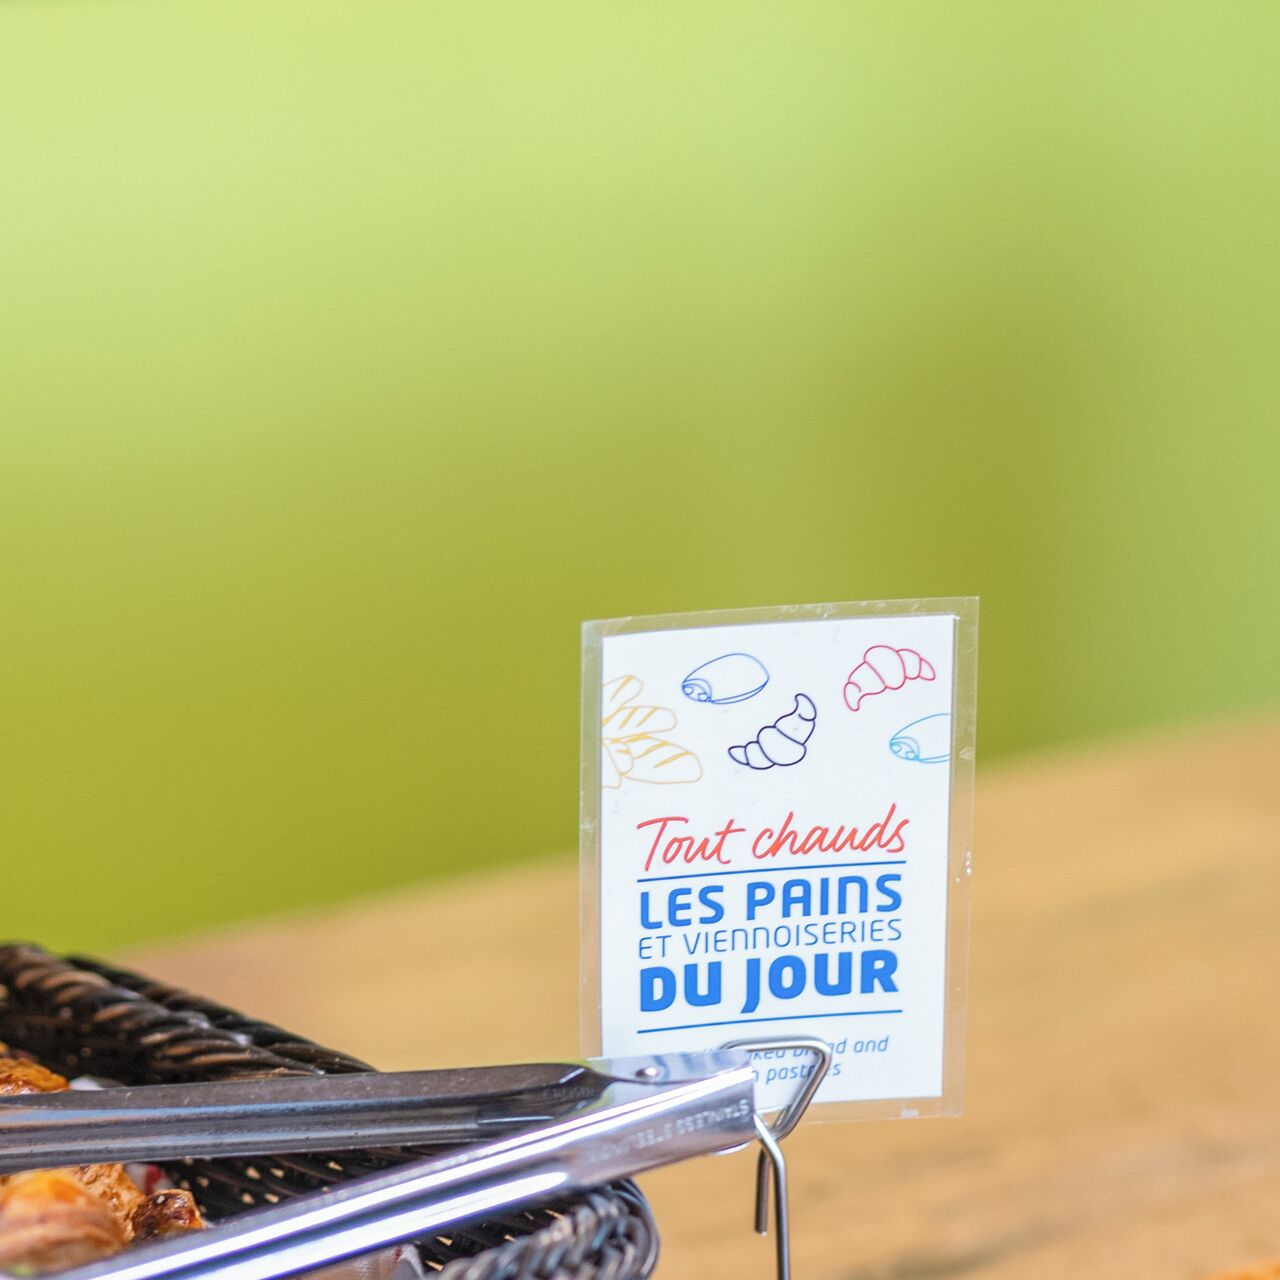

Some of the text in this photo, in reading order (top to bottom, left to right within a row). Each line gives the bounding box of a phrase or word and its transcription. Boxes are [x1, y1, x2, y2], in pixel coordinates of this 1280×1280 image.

[637, 803, 910, 871] Tout chauds
[640, 873, 902, 929] LES PAINS
[639, 918, 902, 959] ET VIENNOISERIES
[640, 949, 898, 1013] DU JOUR
[853, 1035, 889, 1053] and
[765, 1063, 842, 1085] pastrs
